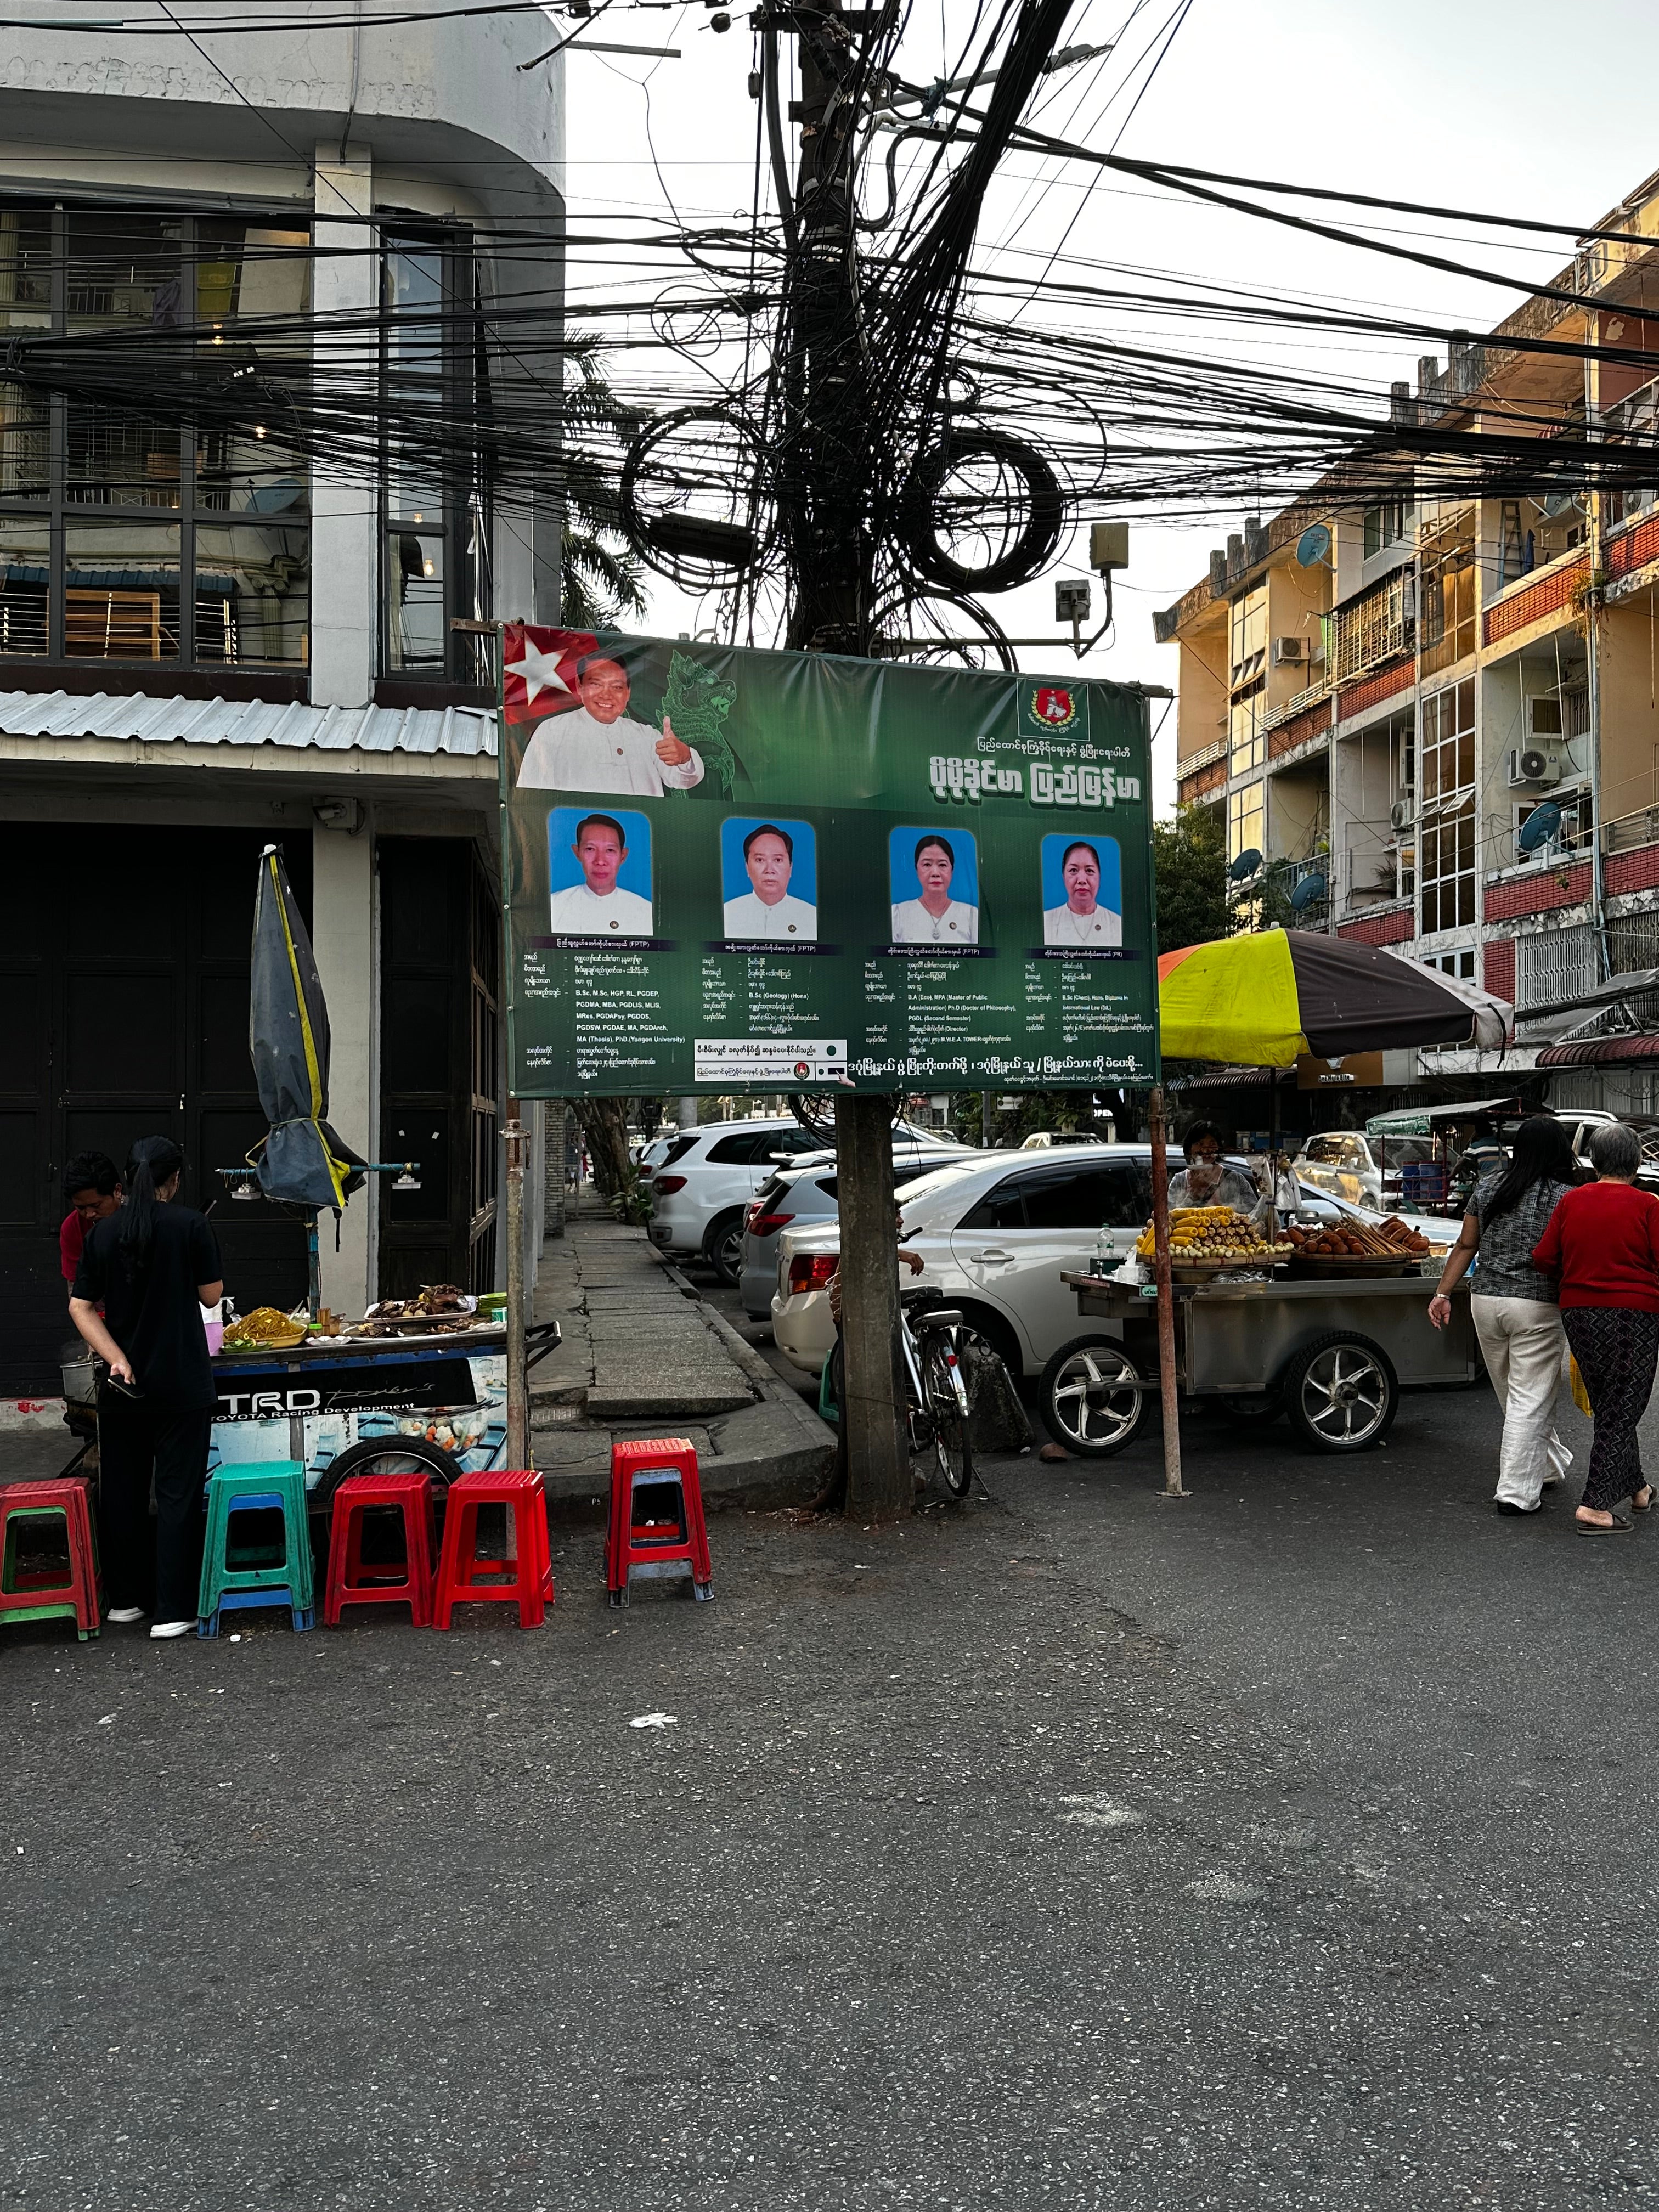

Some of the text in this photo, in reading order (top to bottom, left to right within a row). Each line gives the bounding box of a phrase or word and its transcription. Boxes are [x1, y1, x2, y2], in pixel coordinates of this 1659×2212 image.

[524, 952, 538, 963] အမည်
[218, 1389, 321, 1414] TRD
[271, 1409, 319, 1418] Racing
[324, 1402, 415, 1414] Development
